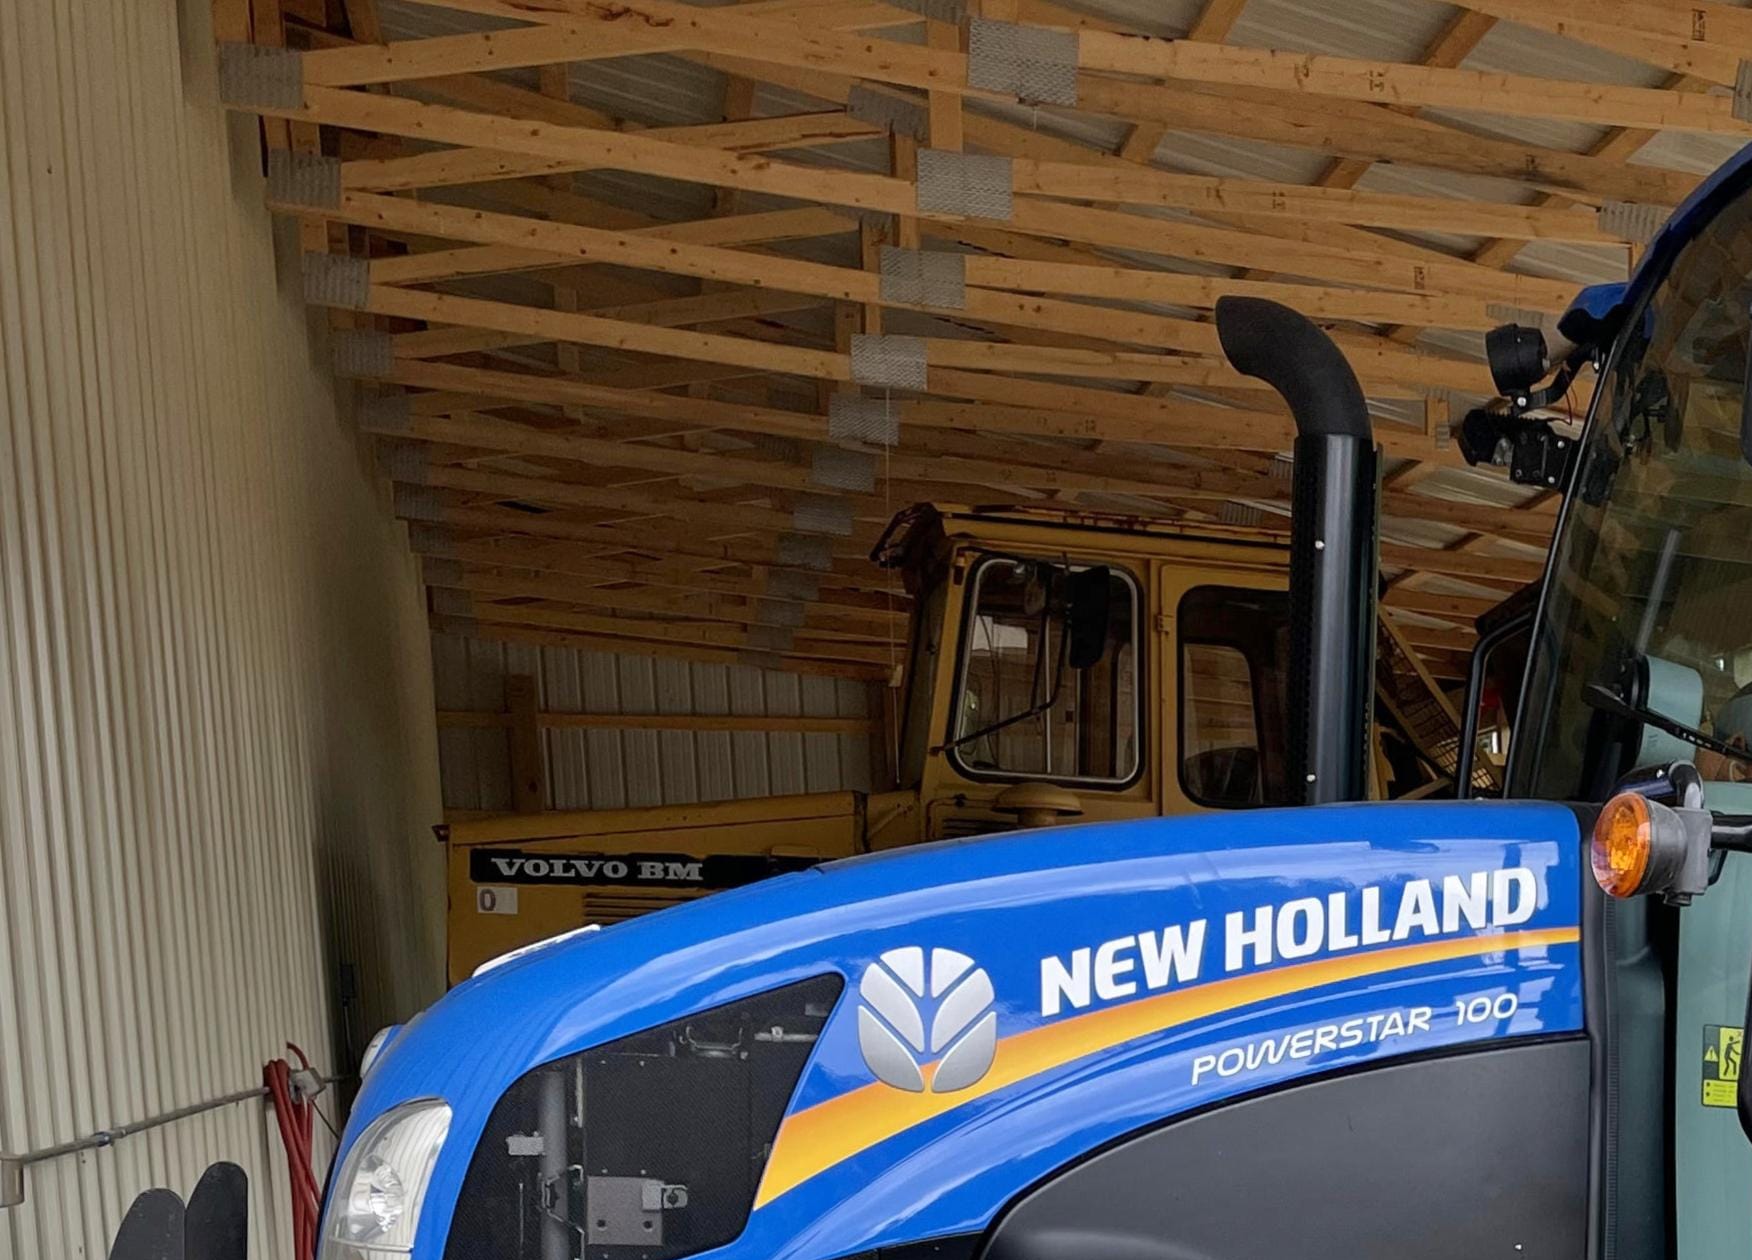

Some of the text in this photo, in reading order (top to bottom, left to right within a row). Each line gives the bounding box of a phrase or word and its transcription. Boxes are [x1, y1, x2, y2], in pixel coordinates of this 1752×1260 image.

[491, 857, 704, 881] VOLVO BM
[1041, 867, 1537, 1018] NEW HOLLAND
[1191, 993, 1519, 1087] POWERSTAR 100
